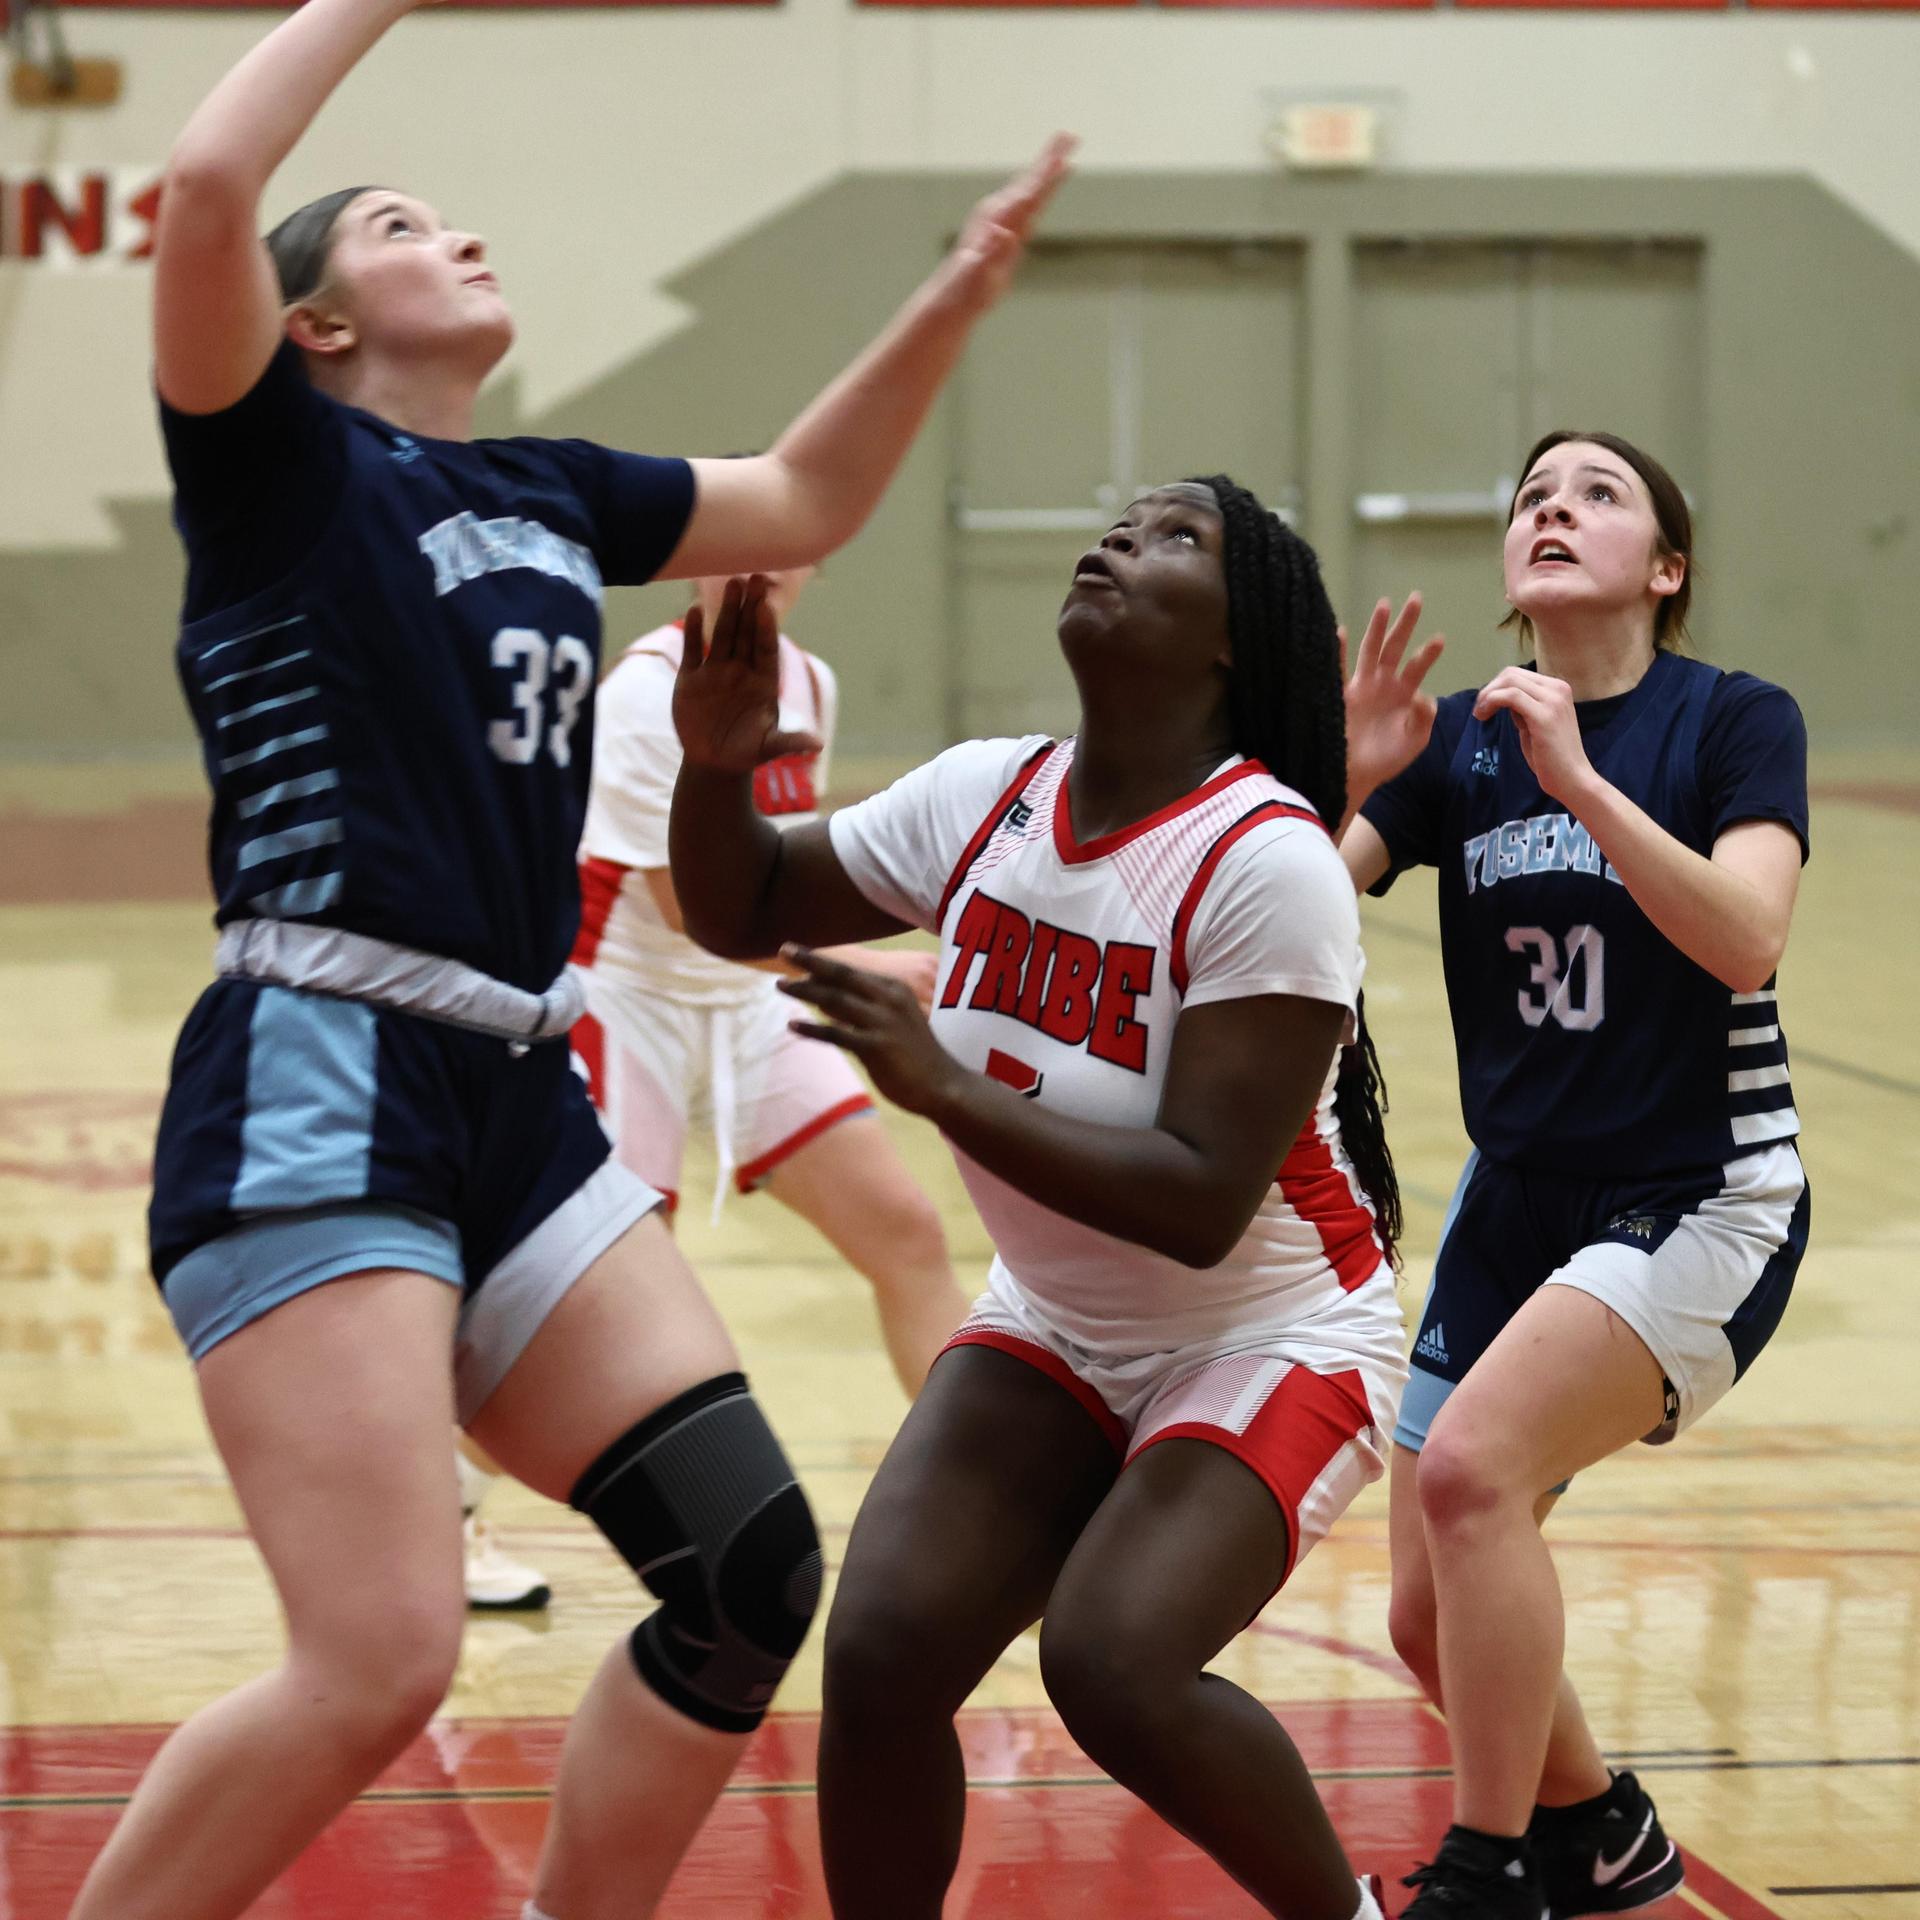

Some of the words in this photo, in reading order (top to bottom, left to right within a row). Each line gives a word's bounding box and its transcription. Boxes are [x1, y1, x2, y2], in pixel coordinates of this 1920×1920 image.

[1463, 813, 1625, 895] YOSEMI
[938, 887, 1157, 1076] TRIBE
[1503, 923, 1605, 1032] 30
[1416, 1341, 1449, 1364] adidas
